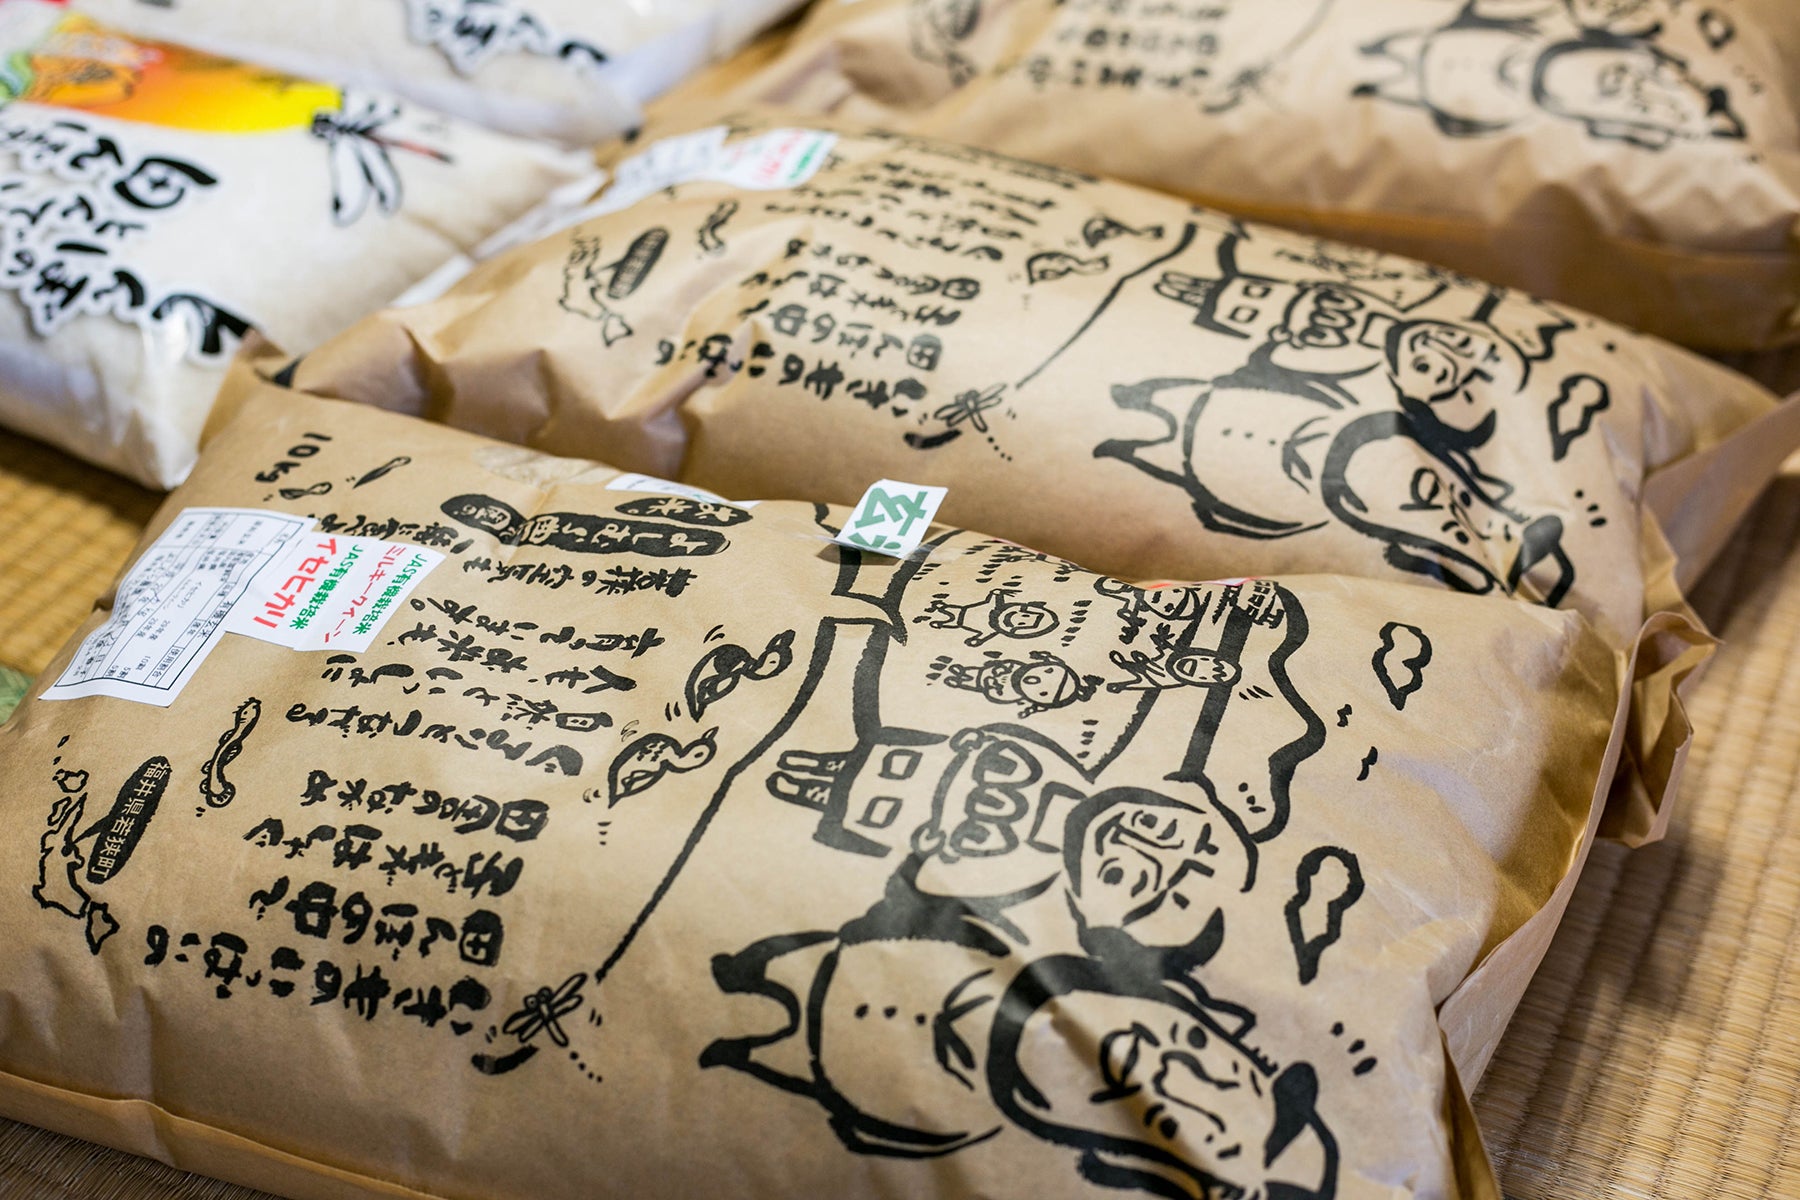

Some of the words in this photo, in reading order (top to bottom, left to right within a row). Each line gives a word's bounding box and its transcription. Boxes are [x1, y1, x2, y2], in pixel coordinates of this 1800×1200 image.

[740, 299, 943, 372] 田んぼの中で
[255, 432, 332, 483] 10kg
[253, 538, 336, 628] イセヒカリ
[290, 545, 362, 629] JAS有機栽培米
[325, 547, 395, 642] ミルキークイーン
[353, 554, 424, 634] JAS有機栽培米
[411, 598, 665, 658] 育っています。
[321, 654, 613, 732] 自然といっしょに
[286, 703, 582, 775] ぐるりとつながる
[92, 755, 171, 882] 福井県若狭町
[249, 876, 504, 967] 田んぼの中で
[143, 924, 491, 1036] いきものいっぱいの
